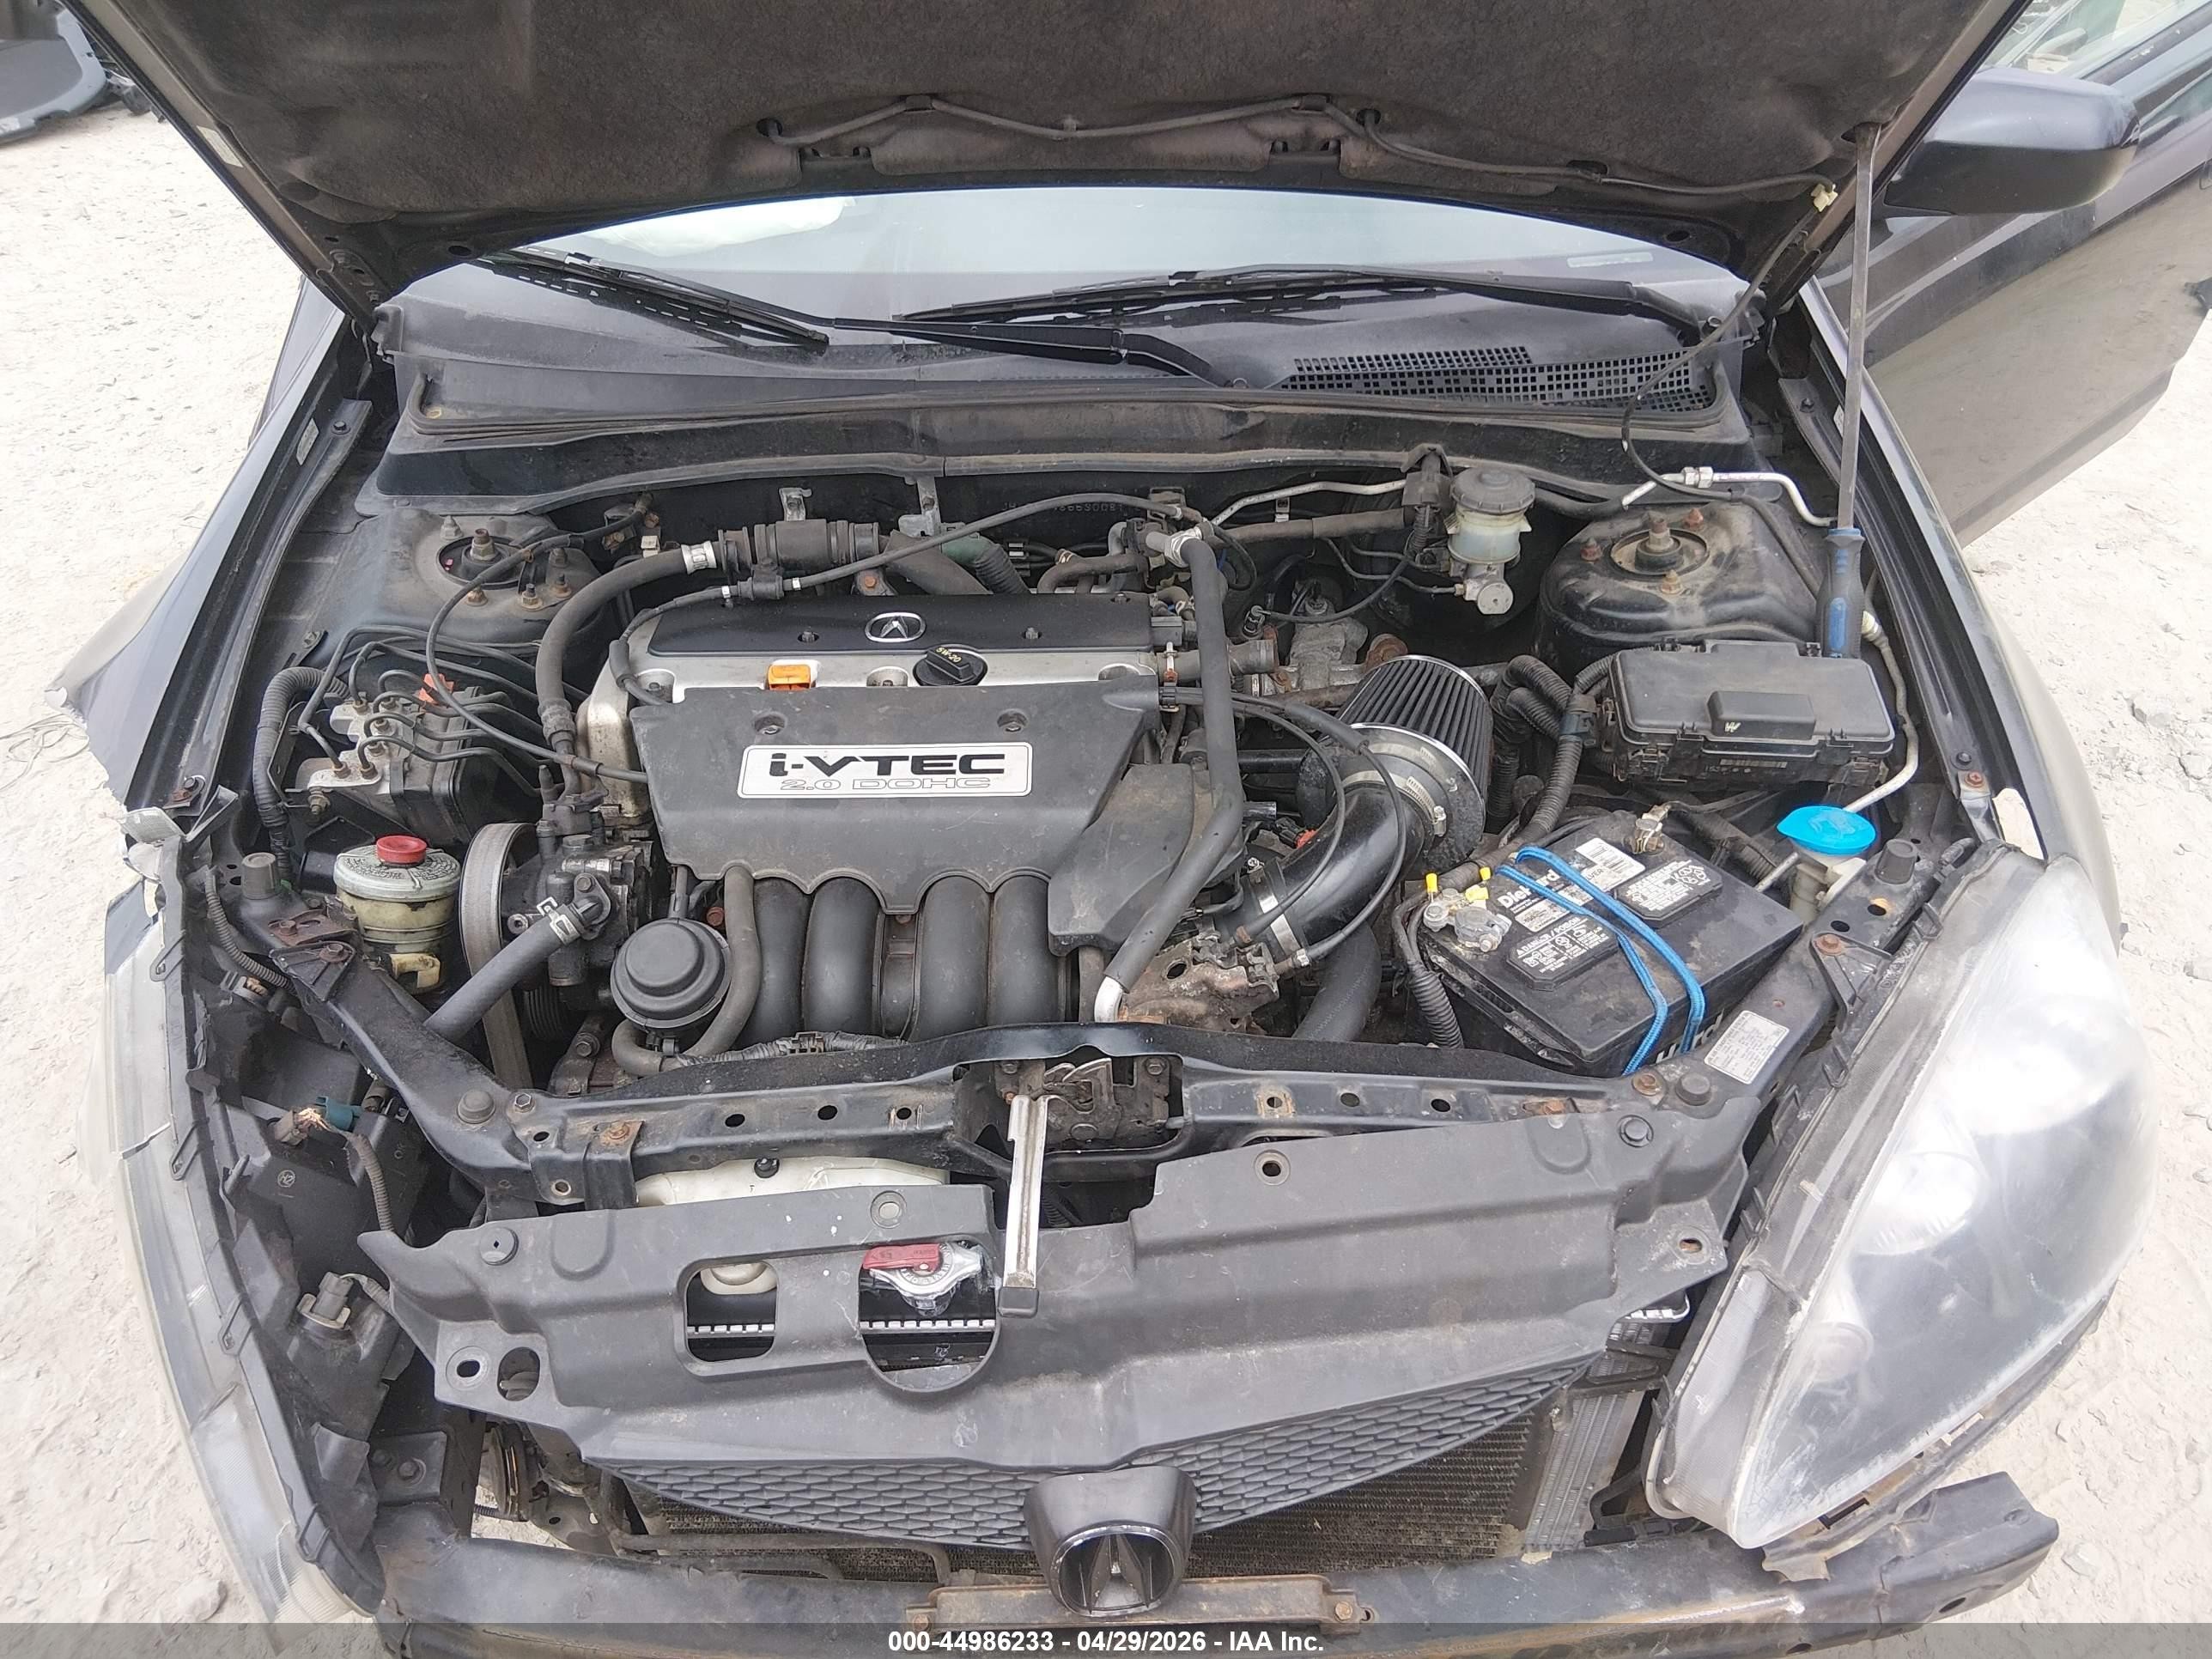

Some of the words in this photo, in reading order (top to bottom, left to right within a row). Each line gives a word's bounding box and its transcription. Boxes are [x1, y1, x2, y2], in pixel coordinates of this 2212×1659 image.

[935, 647, 963, 664] 5W-20
[769, 752, 1006, 777] i-VTEC
[781, 779, 842, 791] 2.0
[852, 776, 992, 790] DOHC
[1497, 868, 1561, 908] DieHrd
